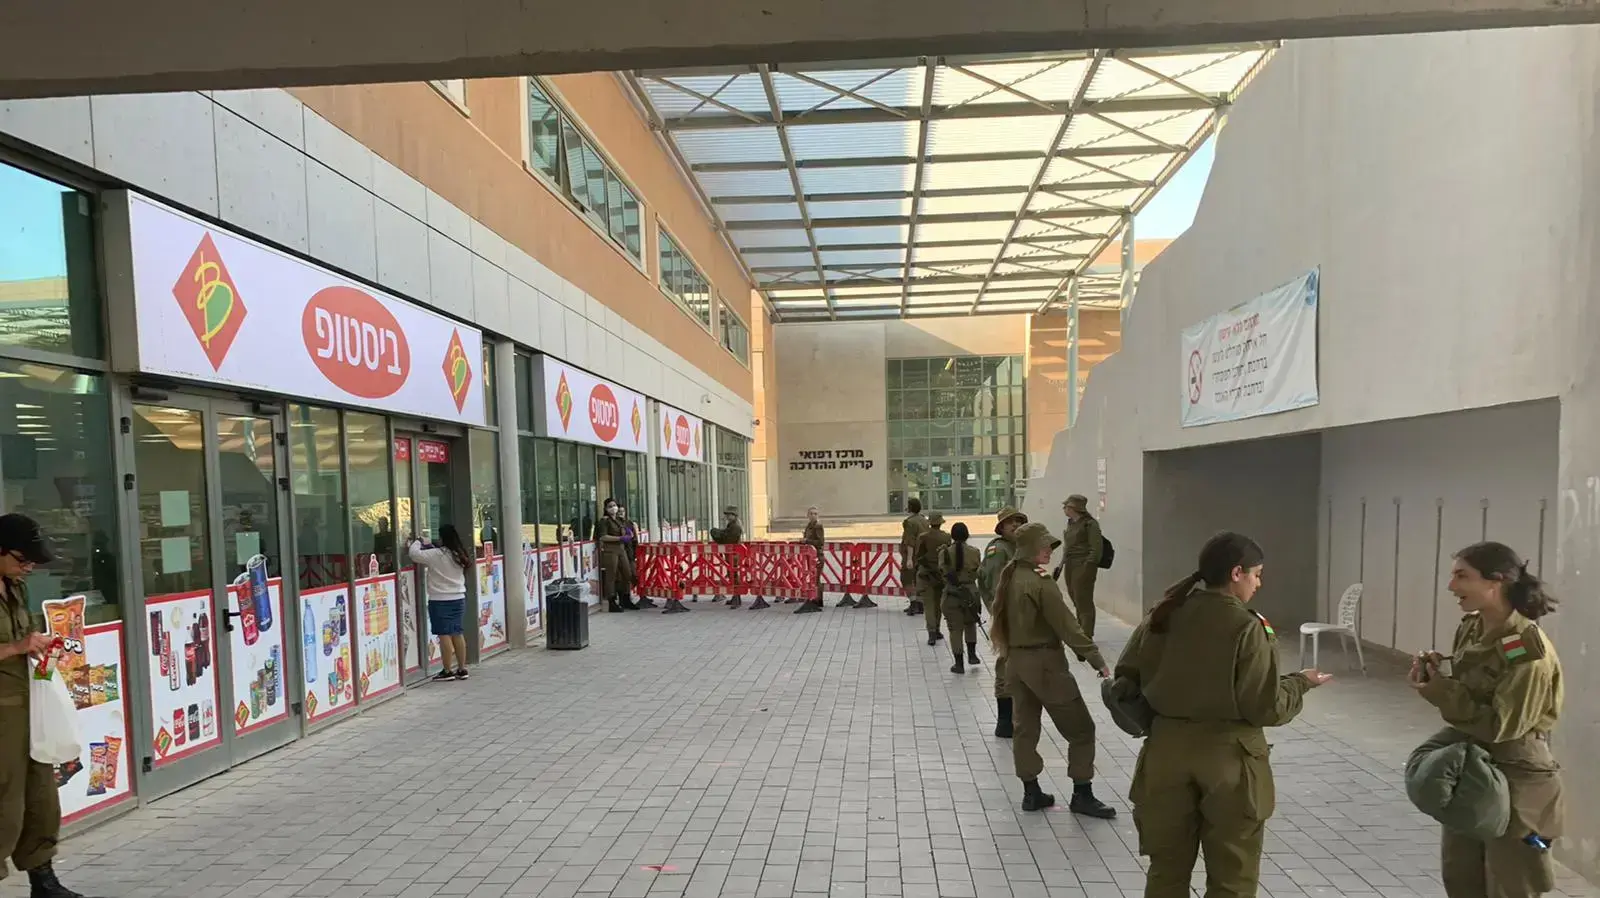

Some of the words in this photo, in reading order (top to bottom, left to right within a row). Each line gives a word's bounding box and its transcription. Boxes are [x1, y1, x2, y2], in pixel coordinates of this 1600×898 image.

[314, 306, 402, 376] ביסטופ
[592, 397, 617, 428] ביסטופ
[798, 450, 832, 459] רפואי
[835, 449, 864, 458] מרכז
[789, 460, 836, 470] ההדרכה
[839, 459, 873, 470] קריית
